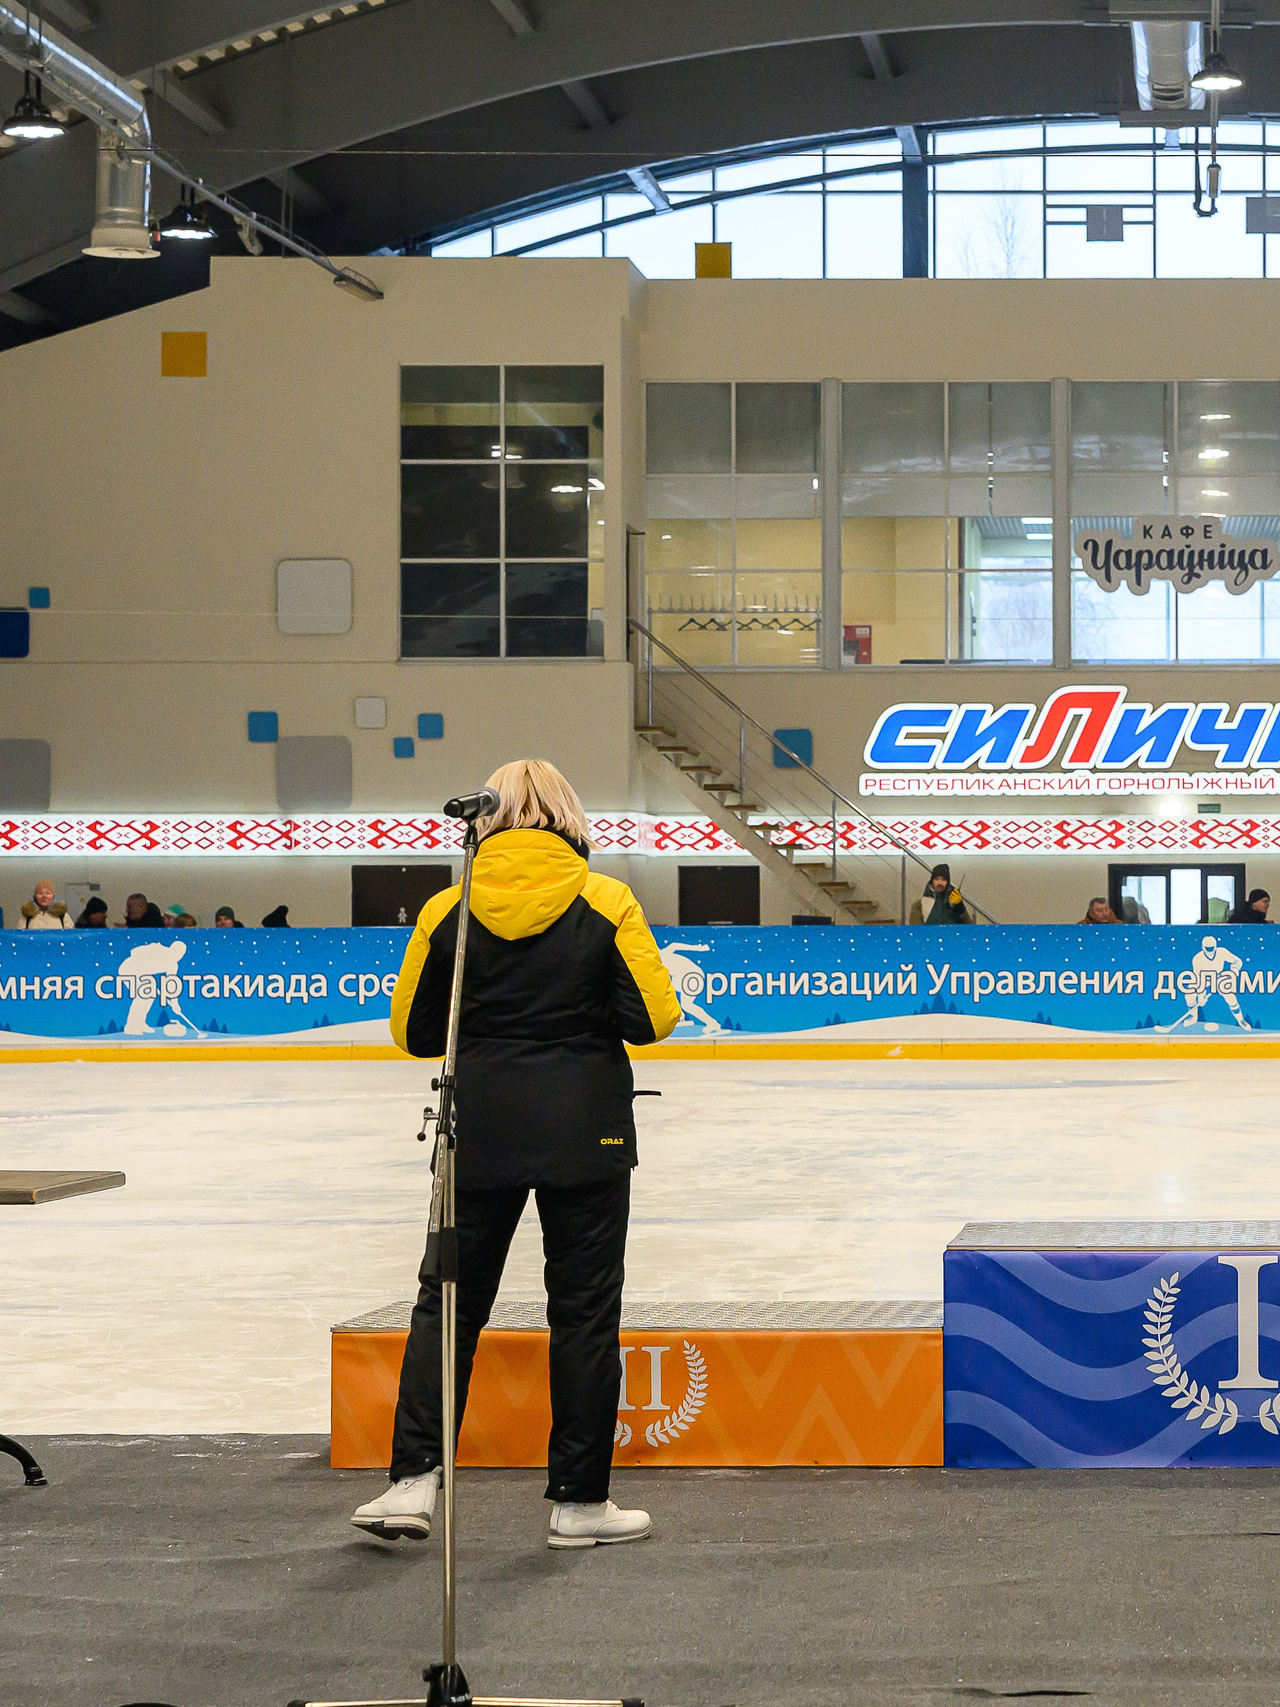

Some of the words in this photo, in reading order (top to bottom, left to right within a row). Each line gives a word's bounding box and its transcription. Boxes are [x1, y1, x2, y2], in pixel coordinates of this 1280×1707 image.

[1142, 524, 1213, 540] КАФЕ
[1083, 538, 1273, 587] Чараўніца
[864, 774, 1091, 791] РЕСПУБЛИКАНСКИЙ
[1096, 773, 1275, 790] ГОРНОЛЫЖНЫЙ
[95, 973, 328, 1006] спартакиада
[681, 963, 917, 1003] организаций
[926, 963, 1144, 1002] Управления
[1217, 1255, 1279, 1389] I
